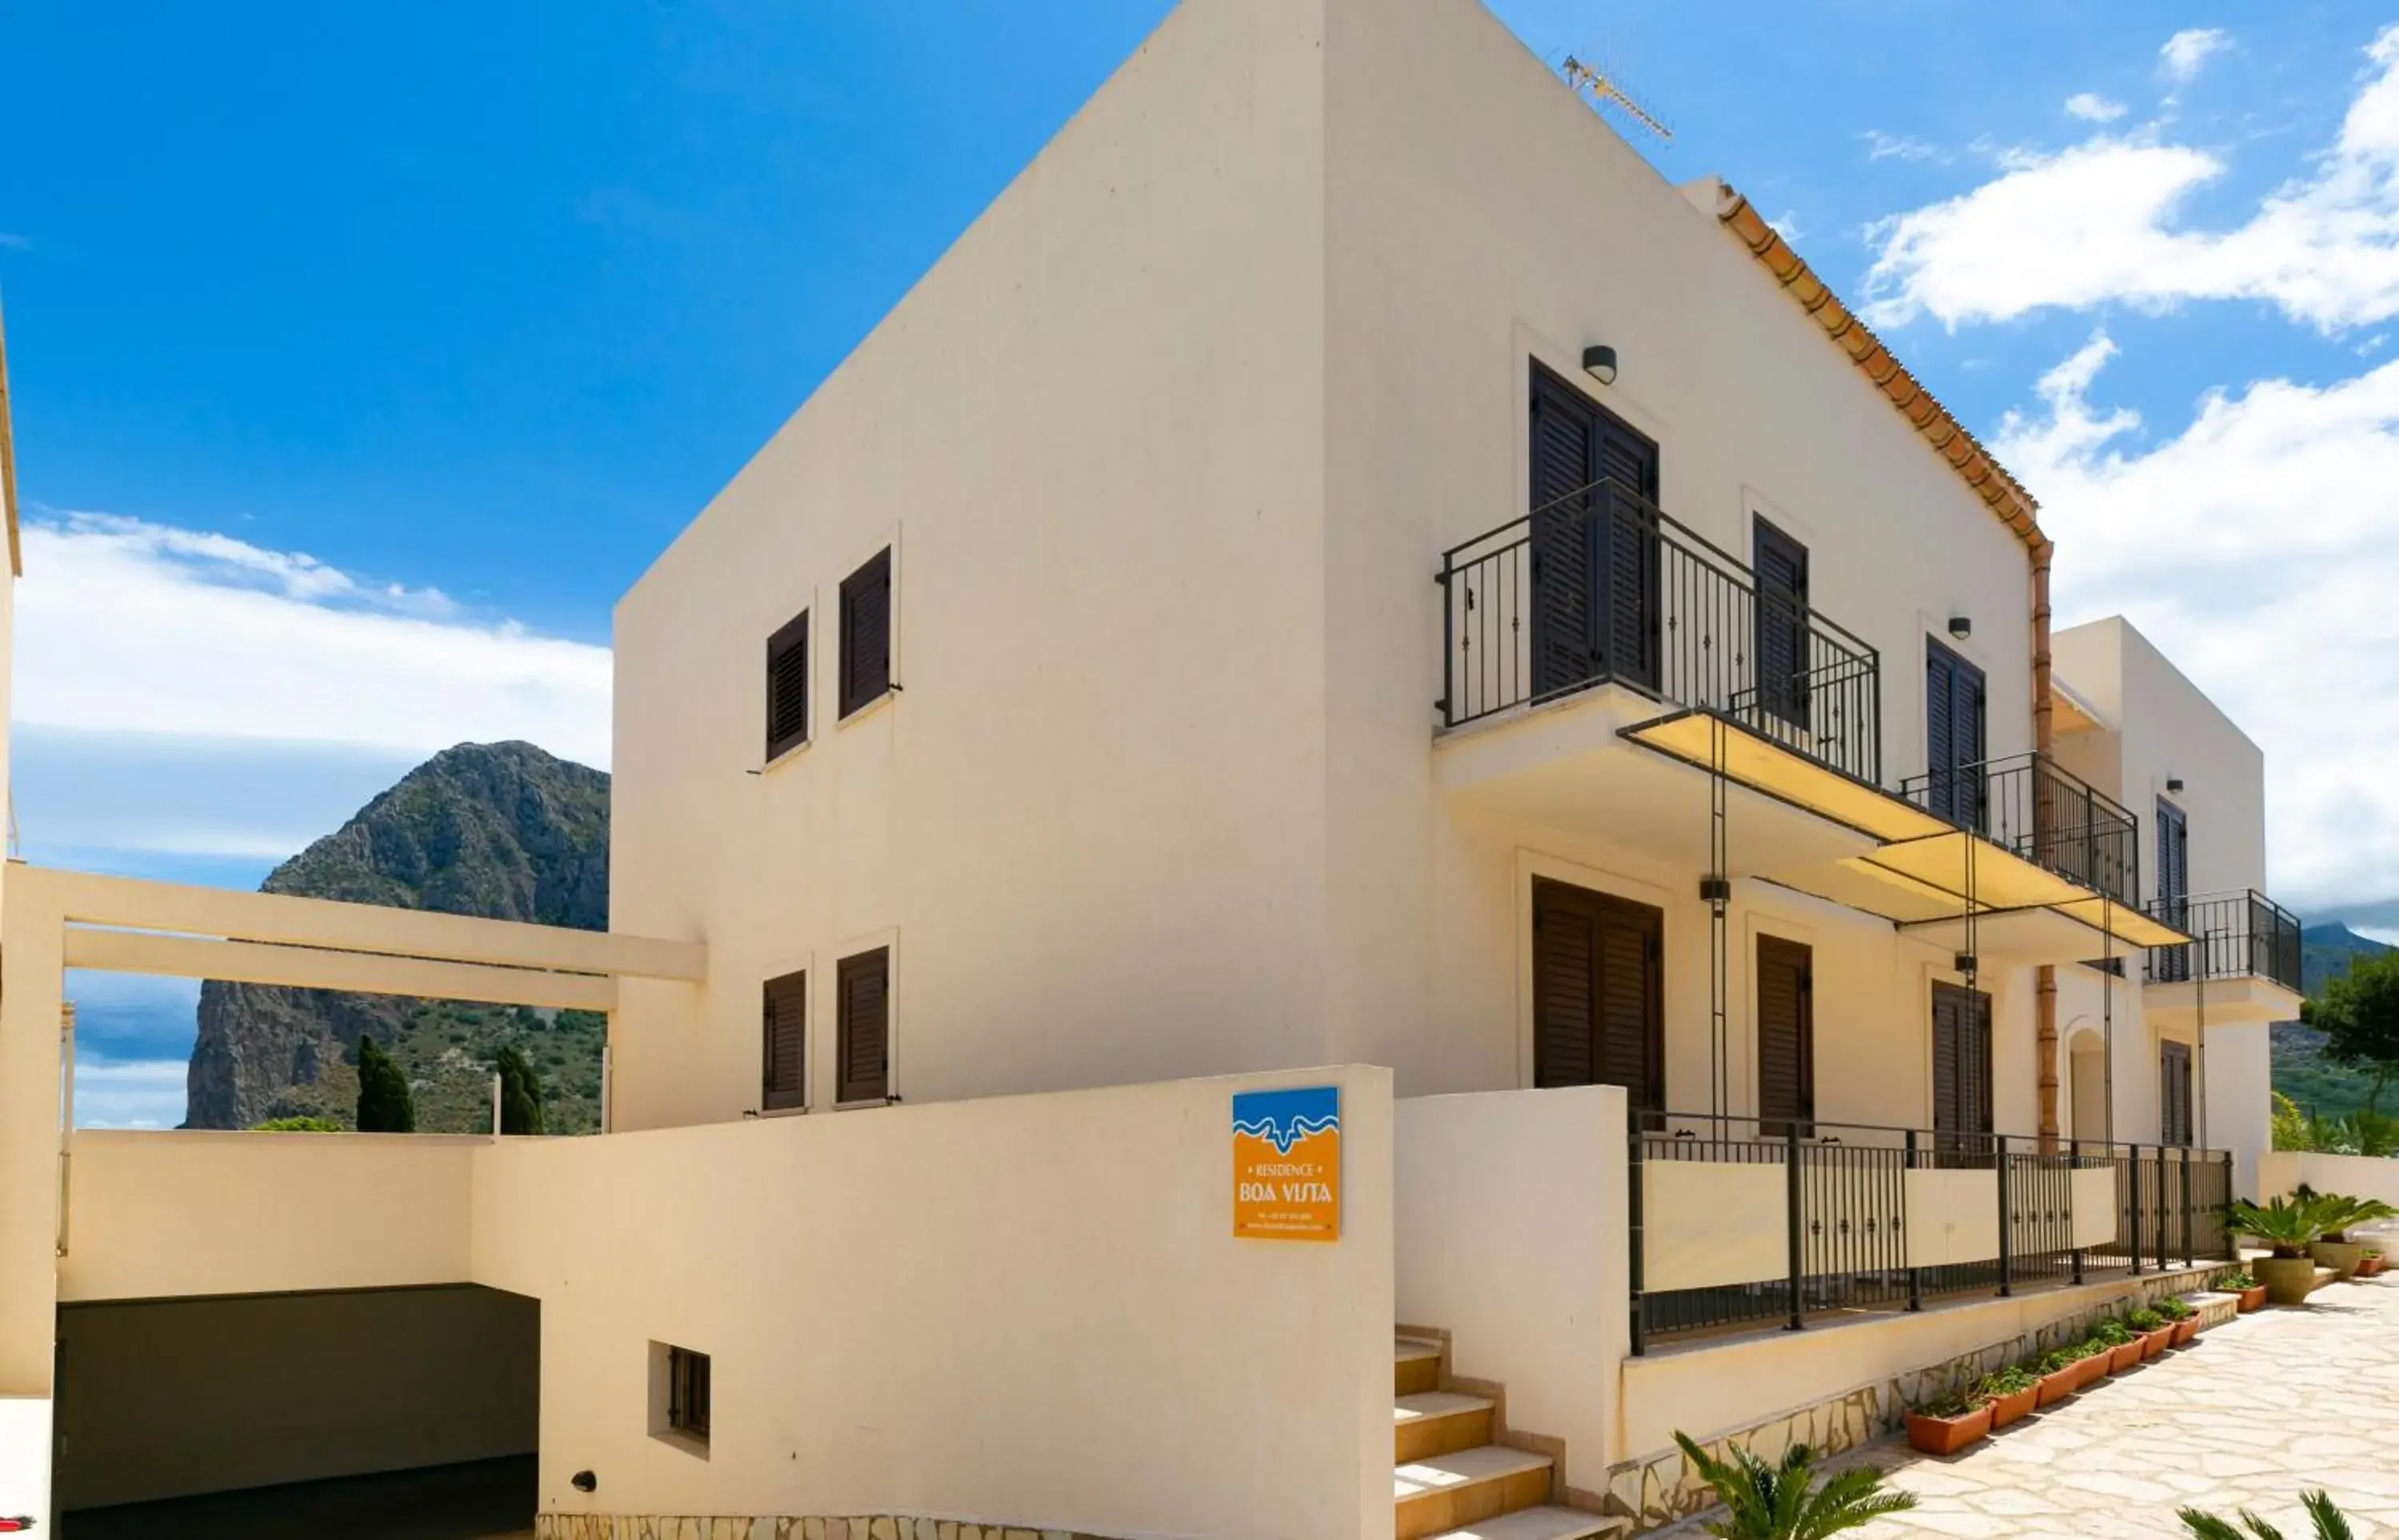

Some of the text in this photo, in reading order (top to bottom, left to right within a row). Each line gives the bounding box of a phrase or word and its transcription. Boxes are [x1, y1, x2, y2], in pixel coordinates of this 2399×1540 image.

[1256, 1163, 1314, 1177] RESIDENCE
[1239, 1182, 1333, 1203] BOA VISTA
